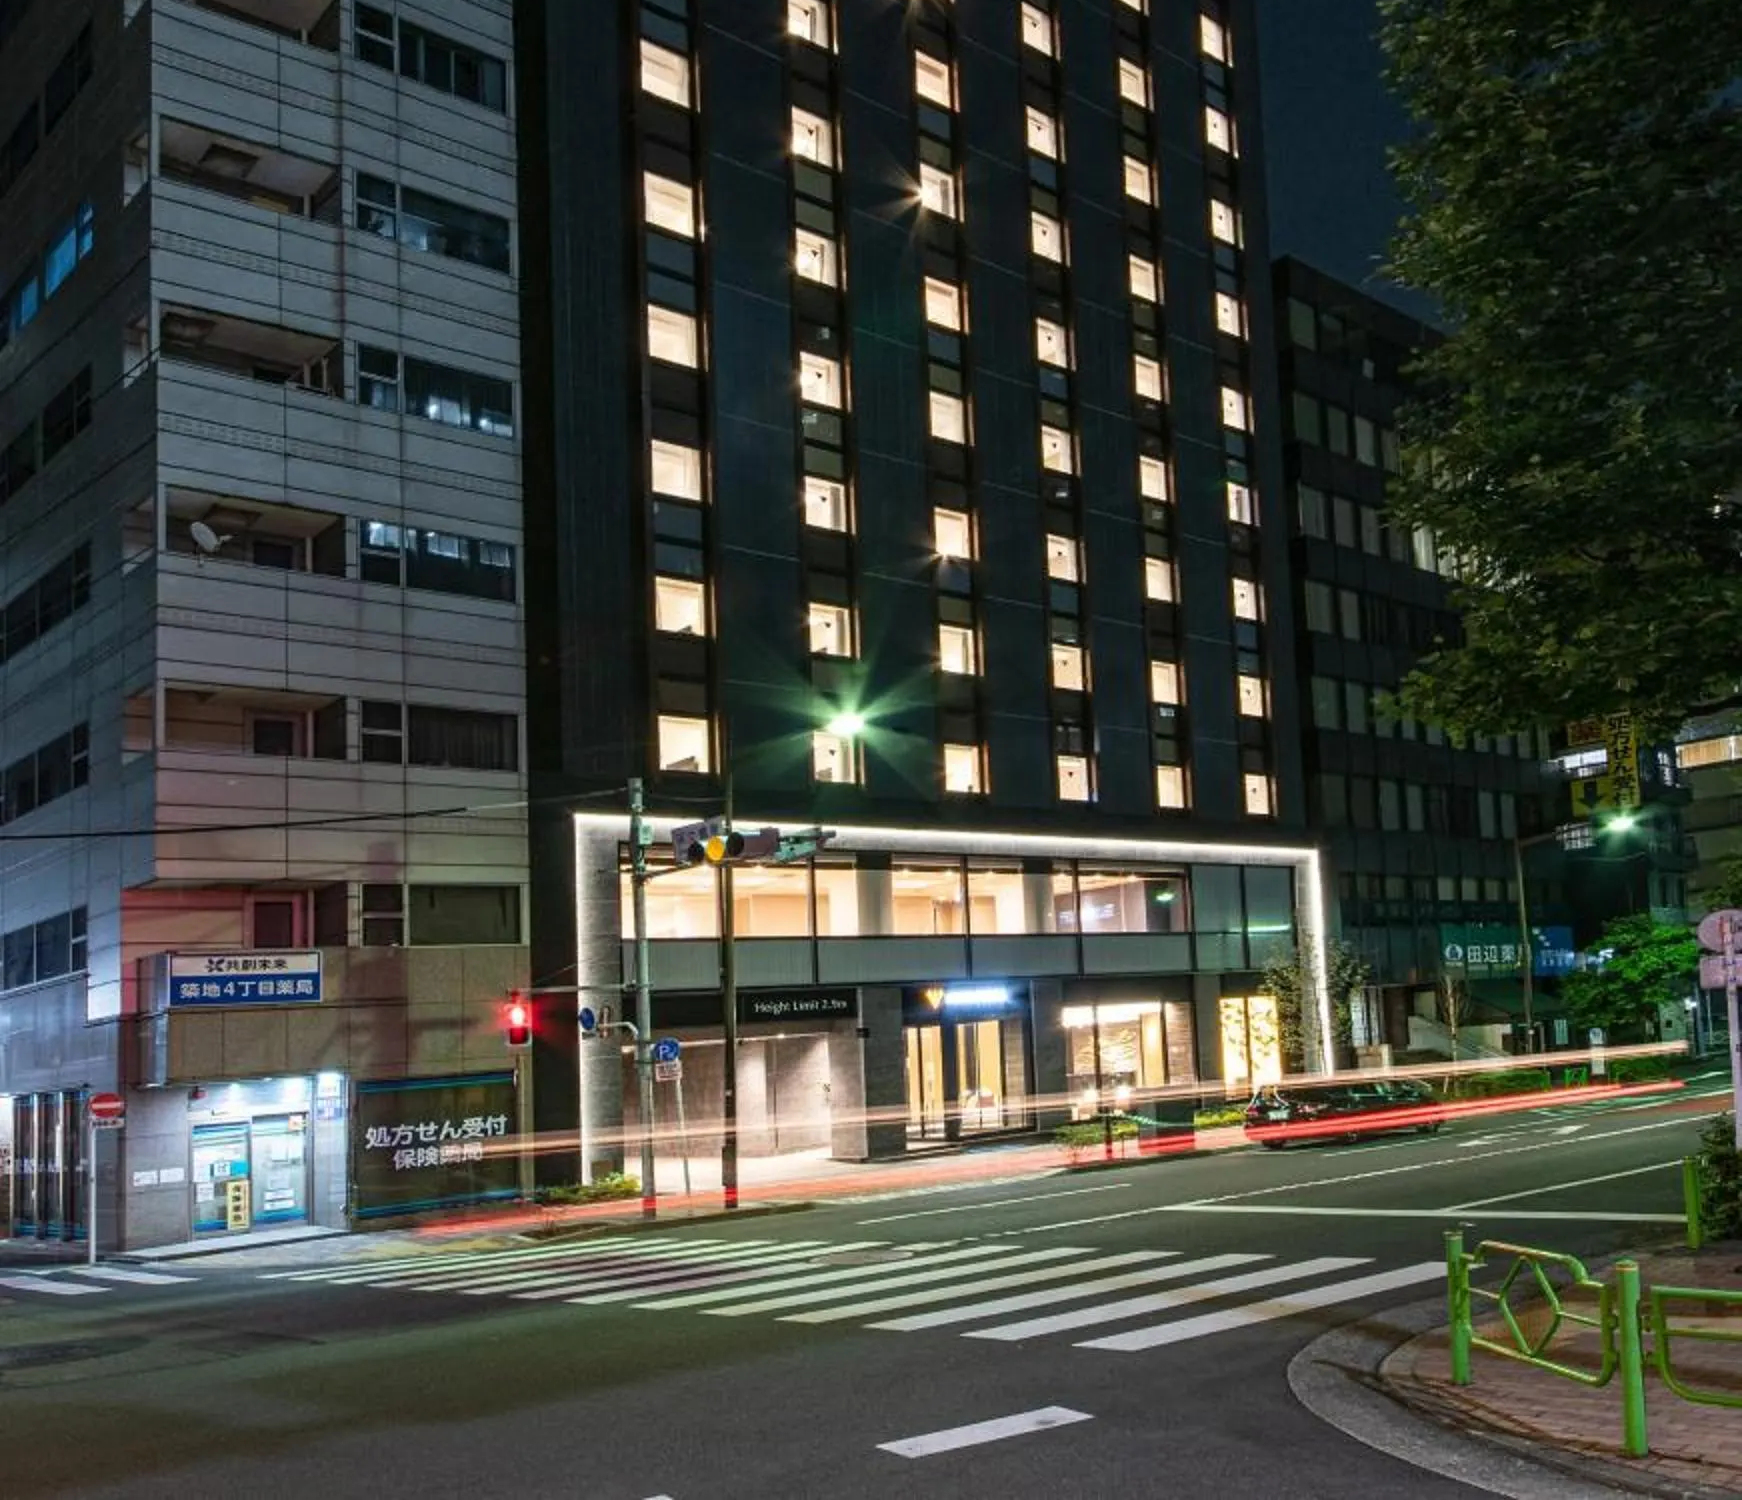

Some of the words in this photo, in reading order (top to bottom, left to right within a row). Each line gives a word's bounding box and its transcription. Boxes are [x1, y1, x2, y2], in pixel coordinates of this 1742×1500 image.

[179, 979, 314, 999] 築地4丁目薬局
[754, 1001, 791, 1015] Height
[365, 1114, 508, 1149] 処方せん受付
